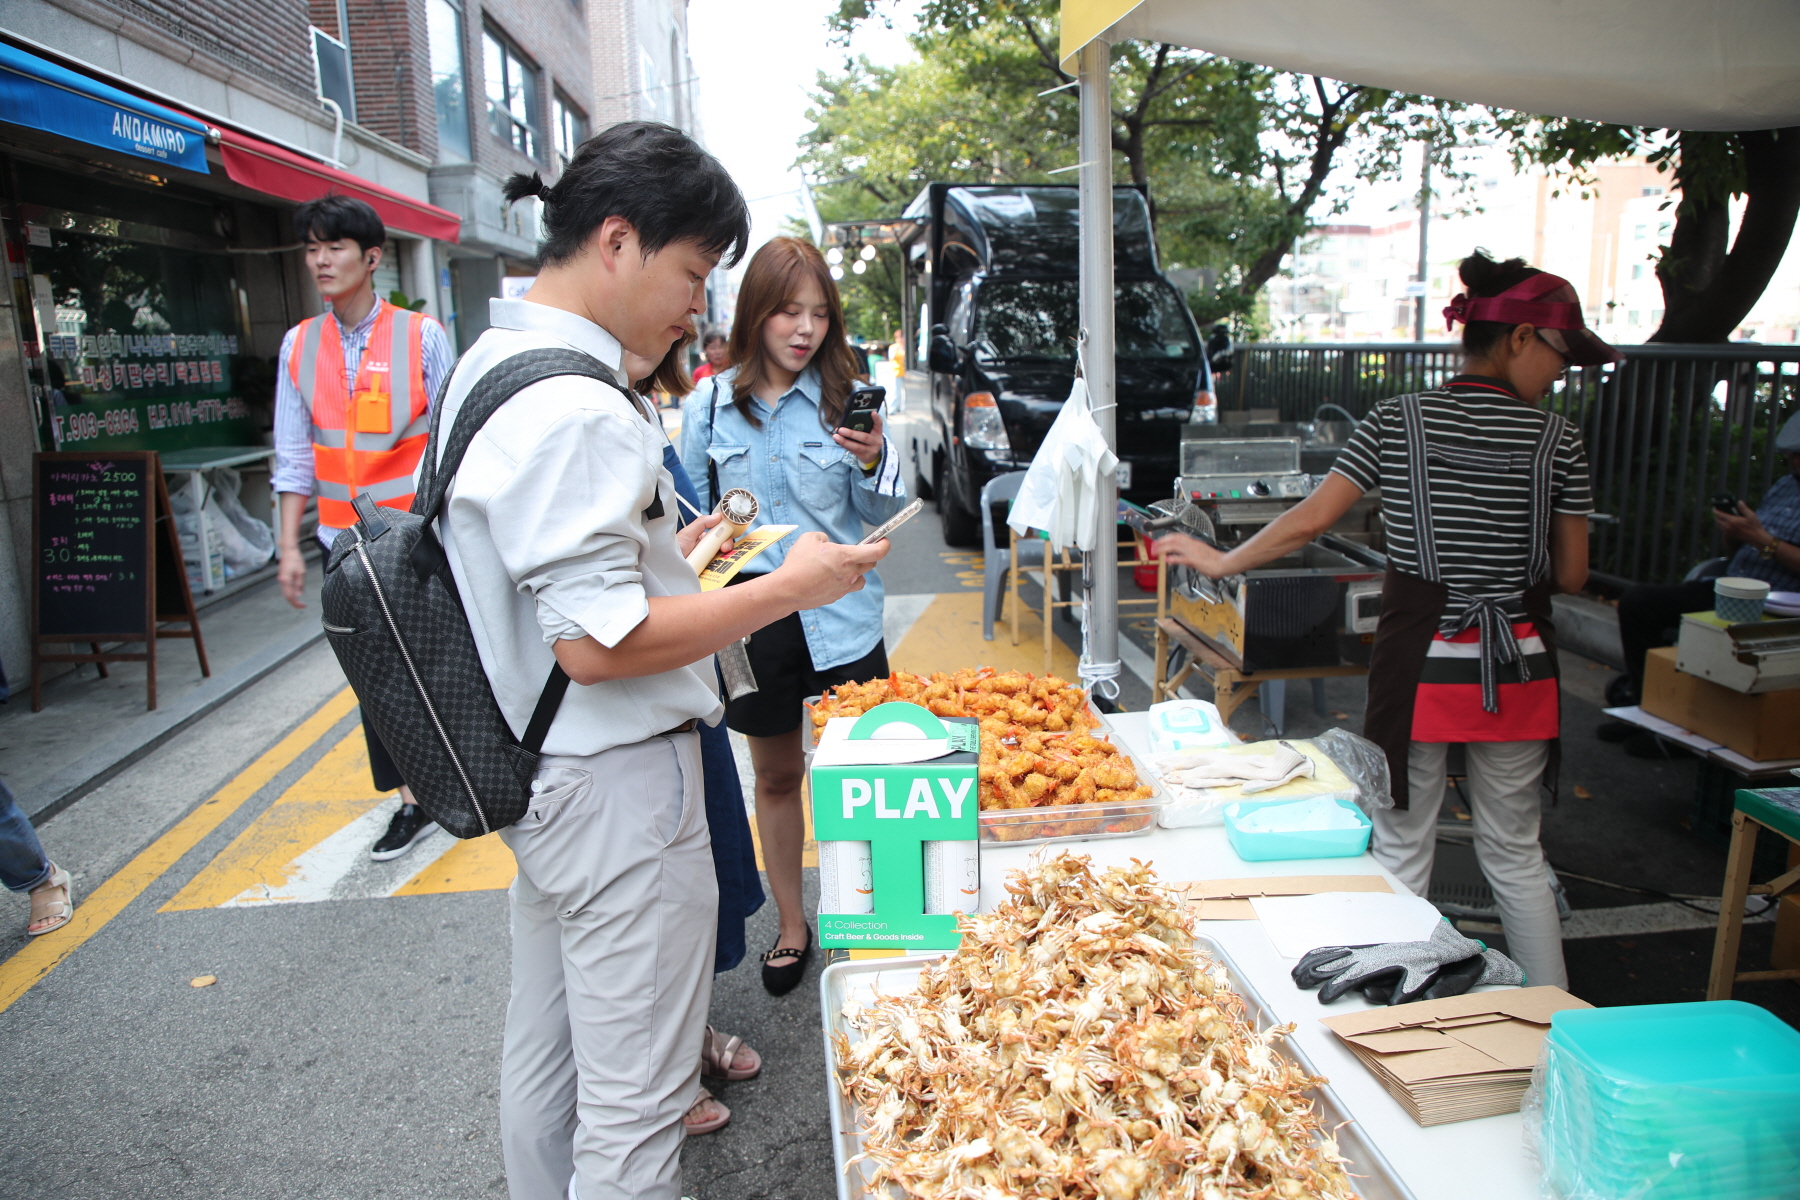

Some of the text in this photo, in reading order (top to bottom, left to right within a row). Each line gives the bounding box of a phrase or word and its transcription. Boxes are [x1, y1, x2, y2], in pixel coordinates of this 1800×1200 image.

[112, 111, 185, 154] ANDAMIRO
[50, 471, 136, 483] 아메리카노 2500
[841, 778, 974, 819] PLAY
[824, 920, 888, 930] 4 Collection
[825, 932, 845, 940] Craft
[873, 933, 899, 941] Goods
[900, 933, 925, 941] Inside
